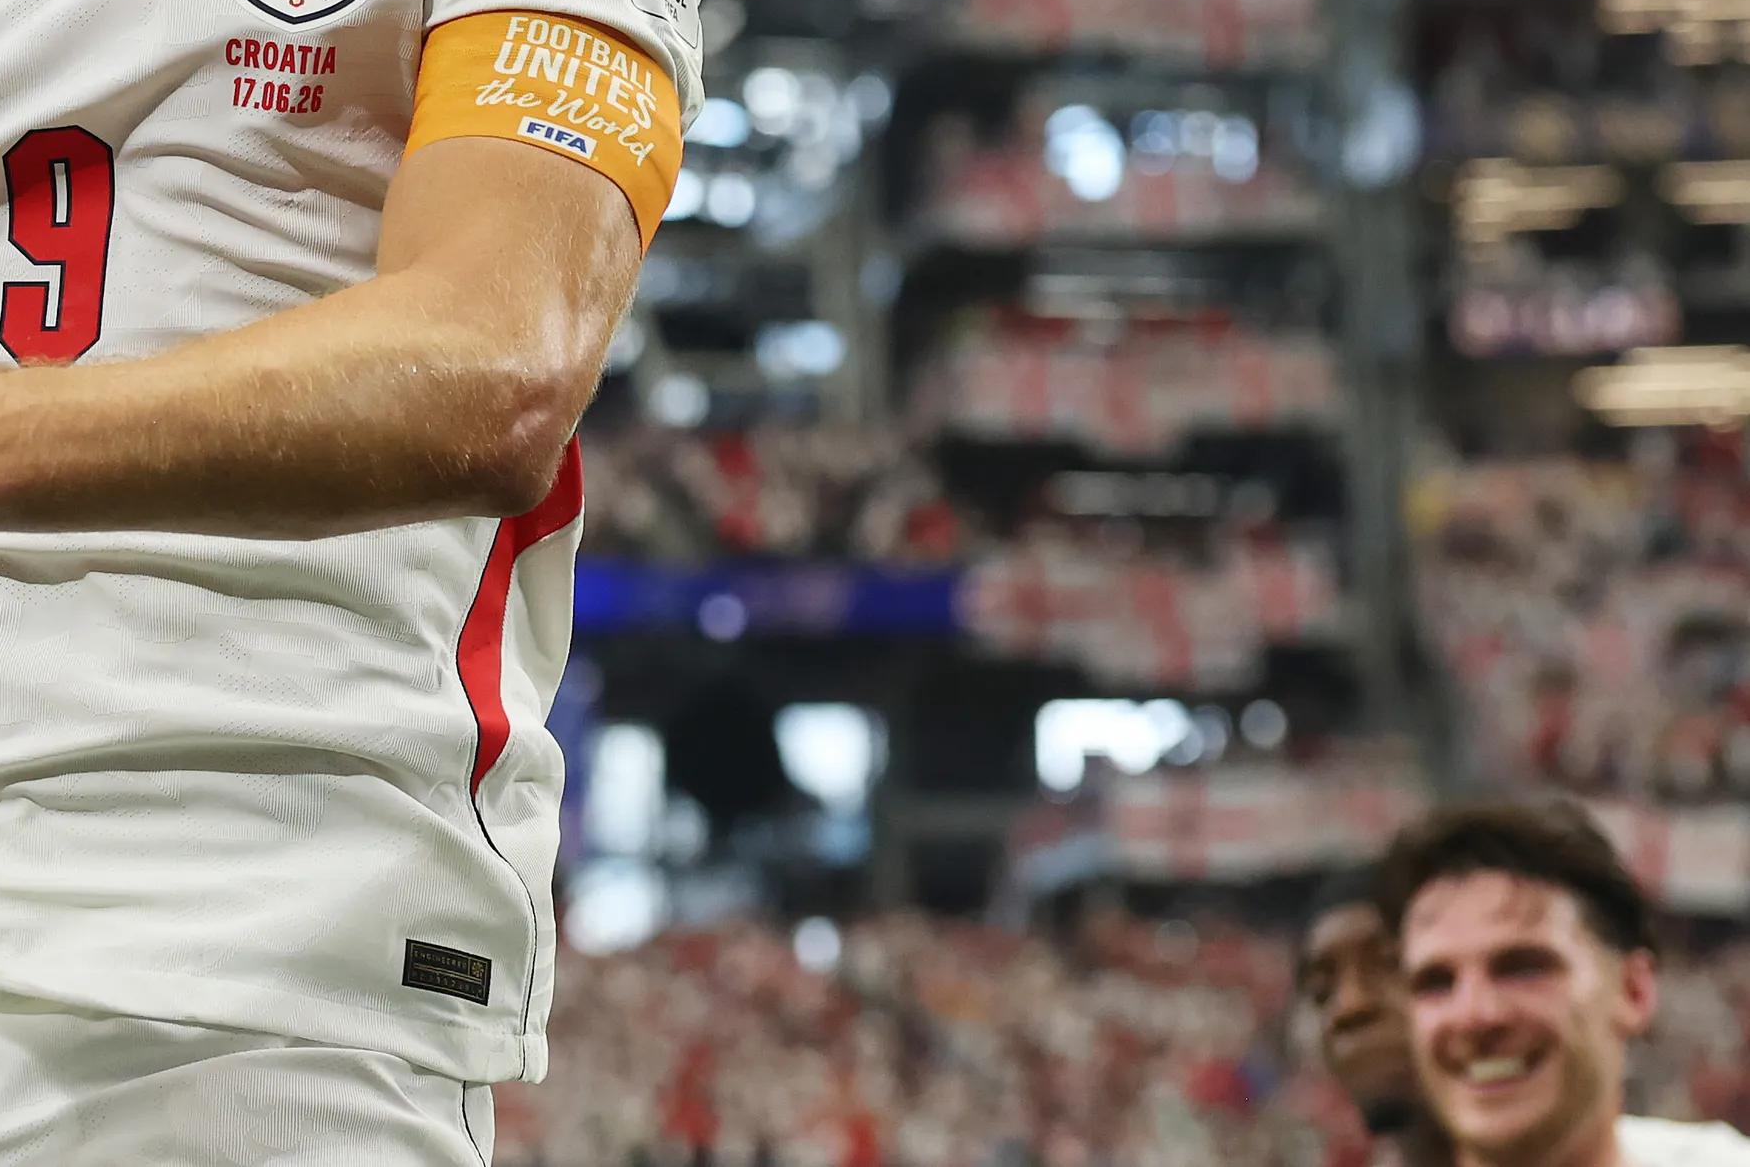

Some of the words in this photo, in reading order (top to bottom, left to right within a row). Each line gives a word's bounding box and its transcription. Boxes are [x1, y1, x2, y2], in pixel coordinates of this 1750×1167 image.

[225, 38, 336, 75] CROATIA
[493, 41, 657, 130] UNITES
[506, 17, 657, 101] FOOTBALL
[232, 76, 325, 114] 17.06.26
[475, 77, 542, 108] the
[546, 88, 655, 167] World
[525, 121, 588, 154] FIFA
